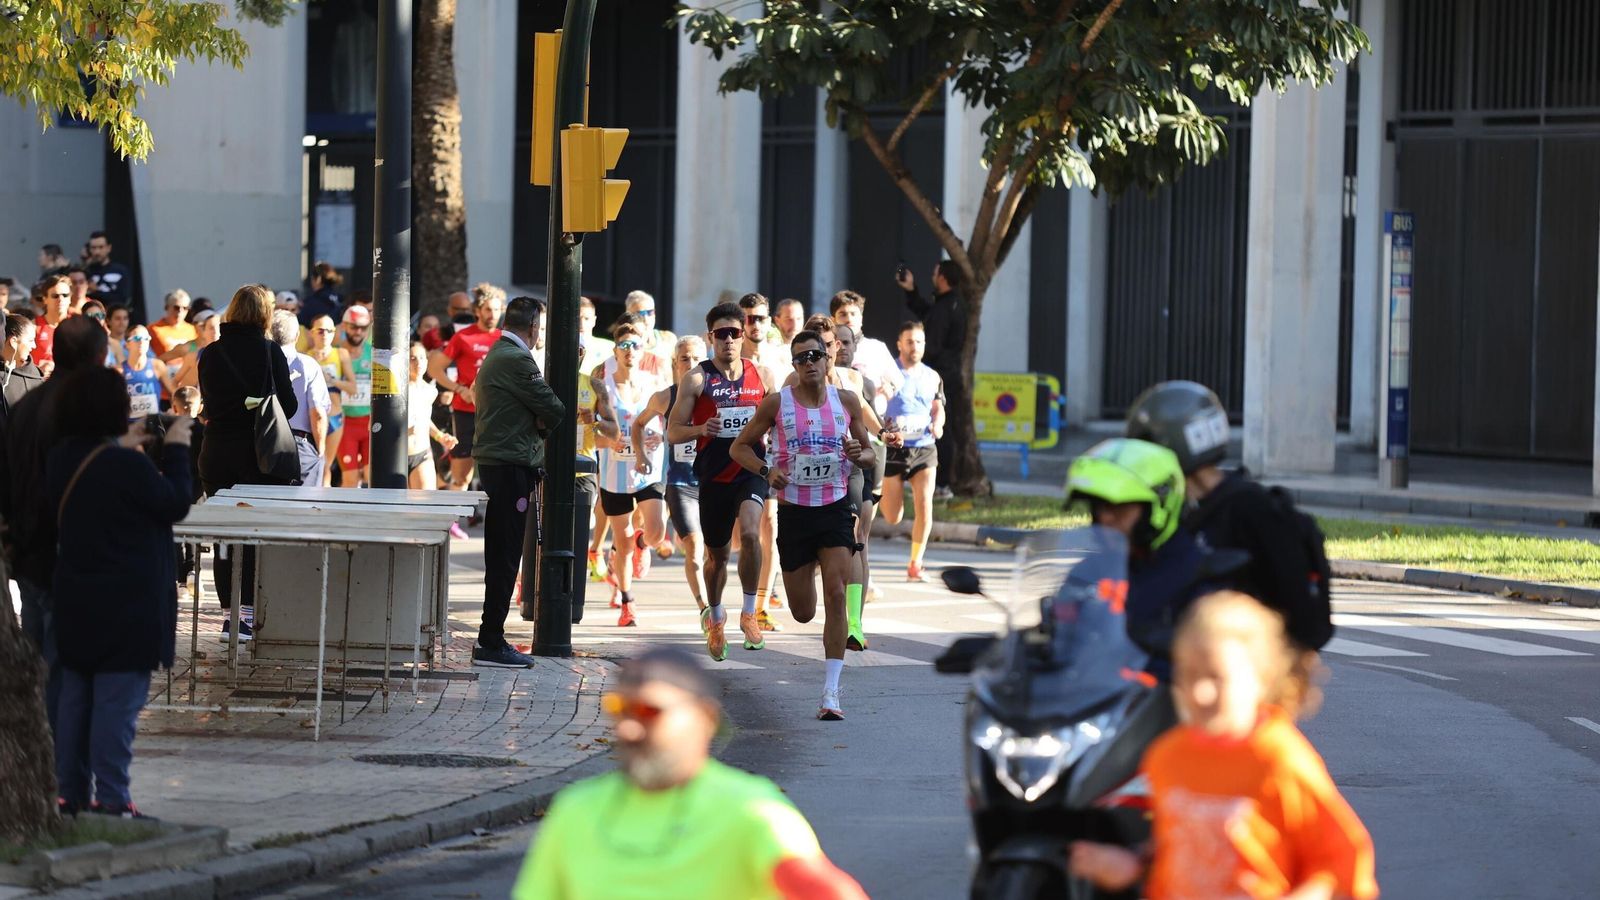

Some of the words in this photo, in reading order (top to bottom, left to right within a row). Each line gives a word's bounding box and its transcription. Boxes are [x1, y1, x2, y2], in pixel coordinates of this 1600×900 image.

[1393, 214, 1412, 231] BUS
[712, 388, 731, 397] RFC
[802, 464, 831, 477] 117
